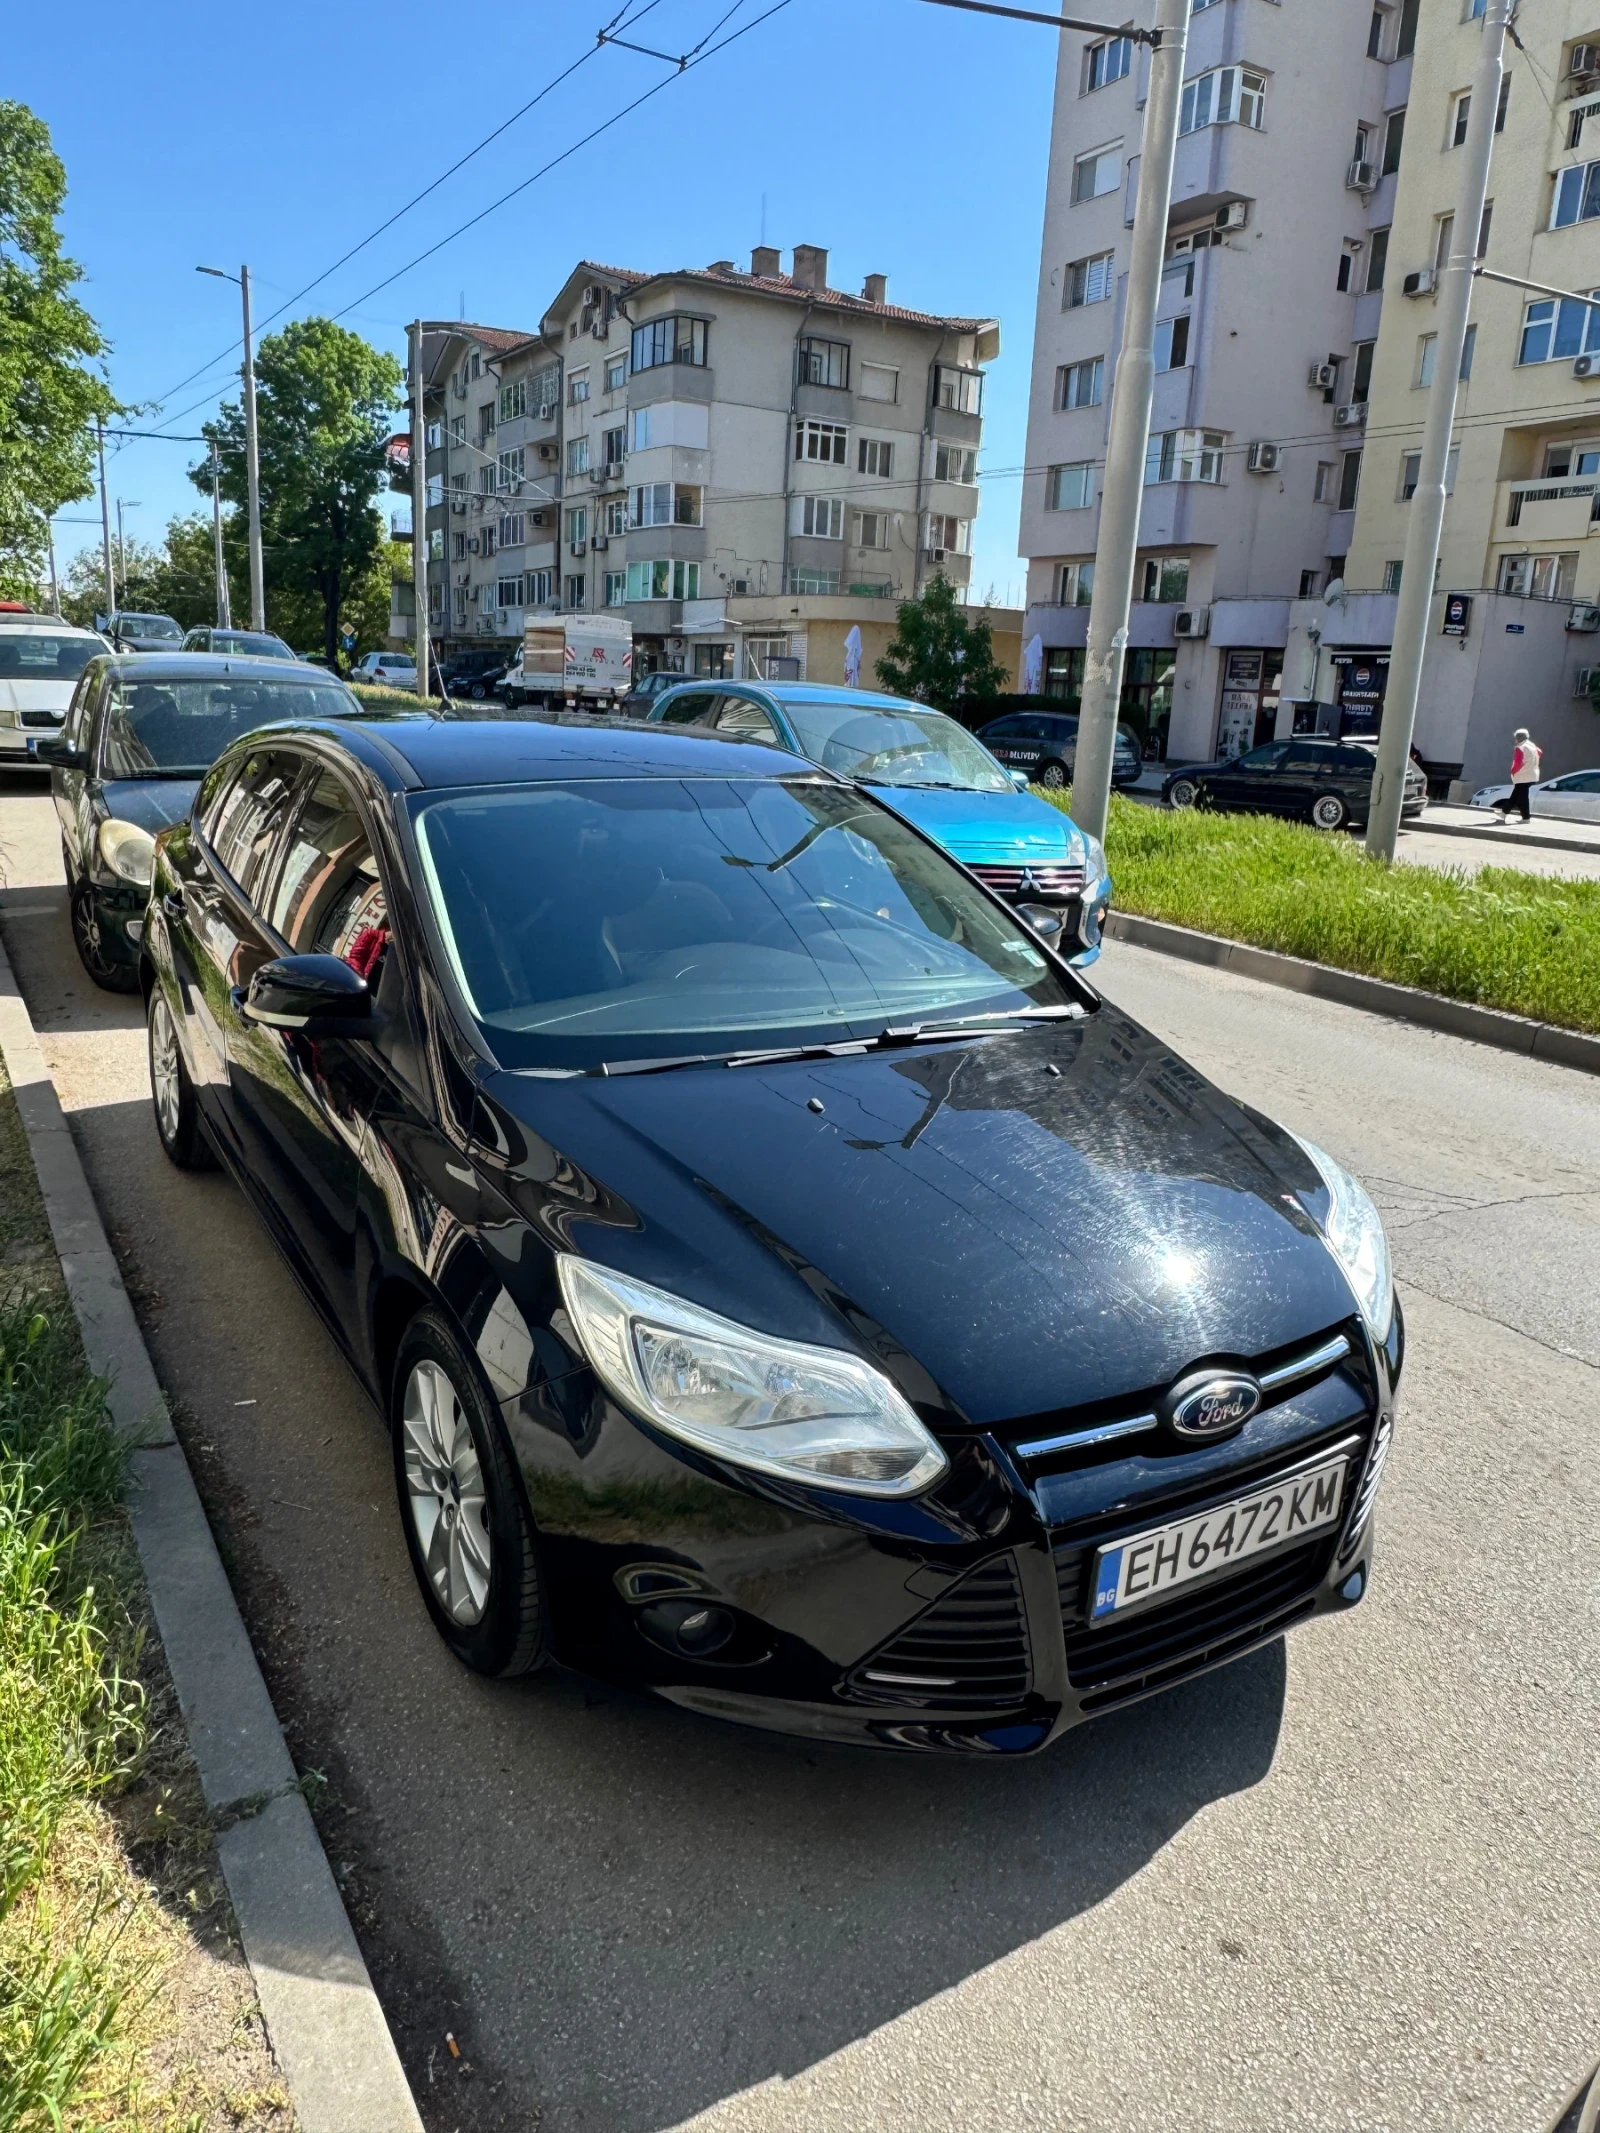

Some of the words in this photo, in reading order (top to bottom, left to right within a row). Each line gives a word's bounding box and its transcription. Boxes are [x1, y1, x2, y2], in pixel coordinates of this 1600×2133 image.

[1009, 750, 1040, 760] DELIVERY
[1198, 1390, 1245, 1428] Ford
[1123, 1470, 1340, 1598] EH6472KM
[1096, 1588, 1116, 1608] BG
